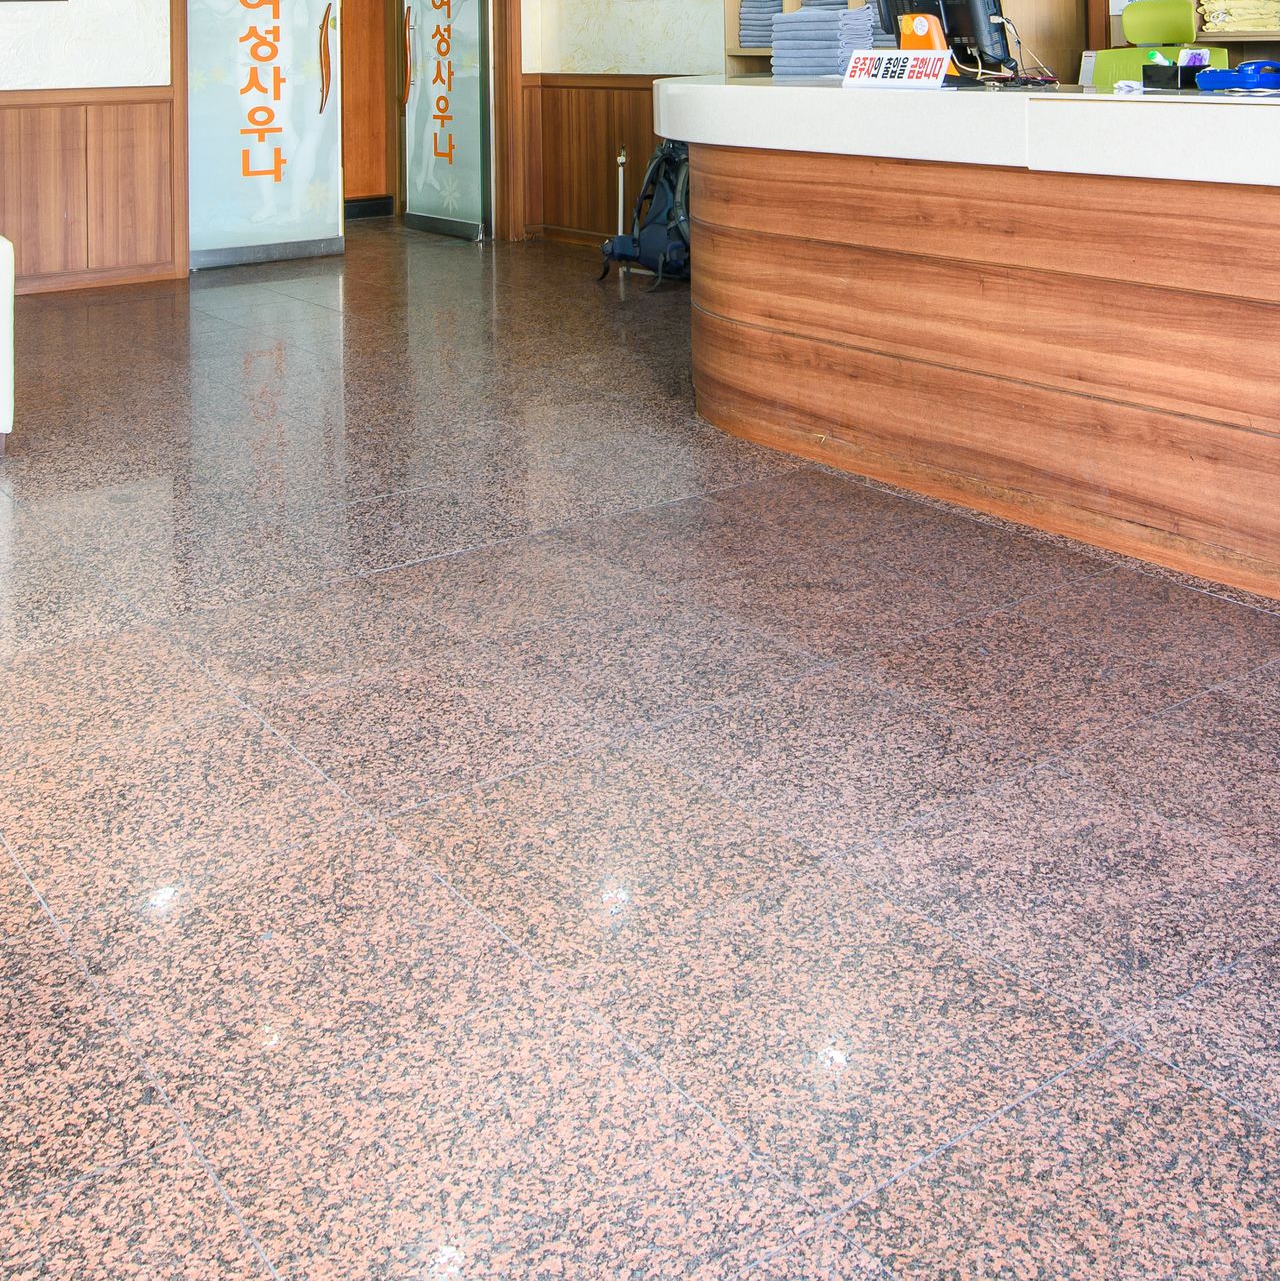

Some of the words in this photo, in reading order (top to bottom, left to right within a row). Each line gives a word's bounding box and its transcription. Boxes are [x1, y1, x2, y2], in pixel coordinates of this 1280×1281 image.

[849, 57, 883, 78] 음주자의
[881, 57, 909, 79] 출입을
[907, 57, 945, 79] 금합니다
